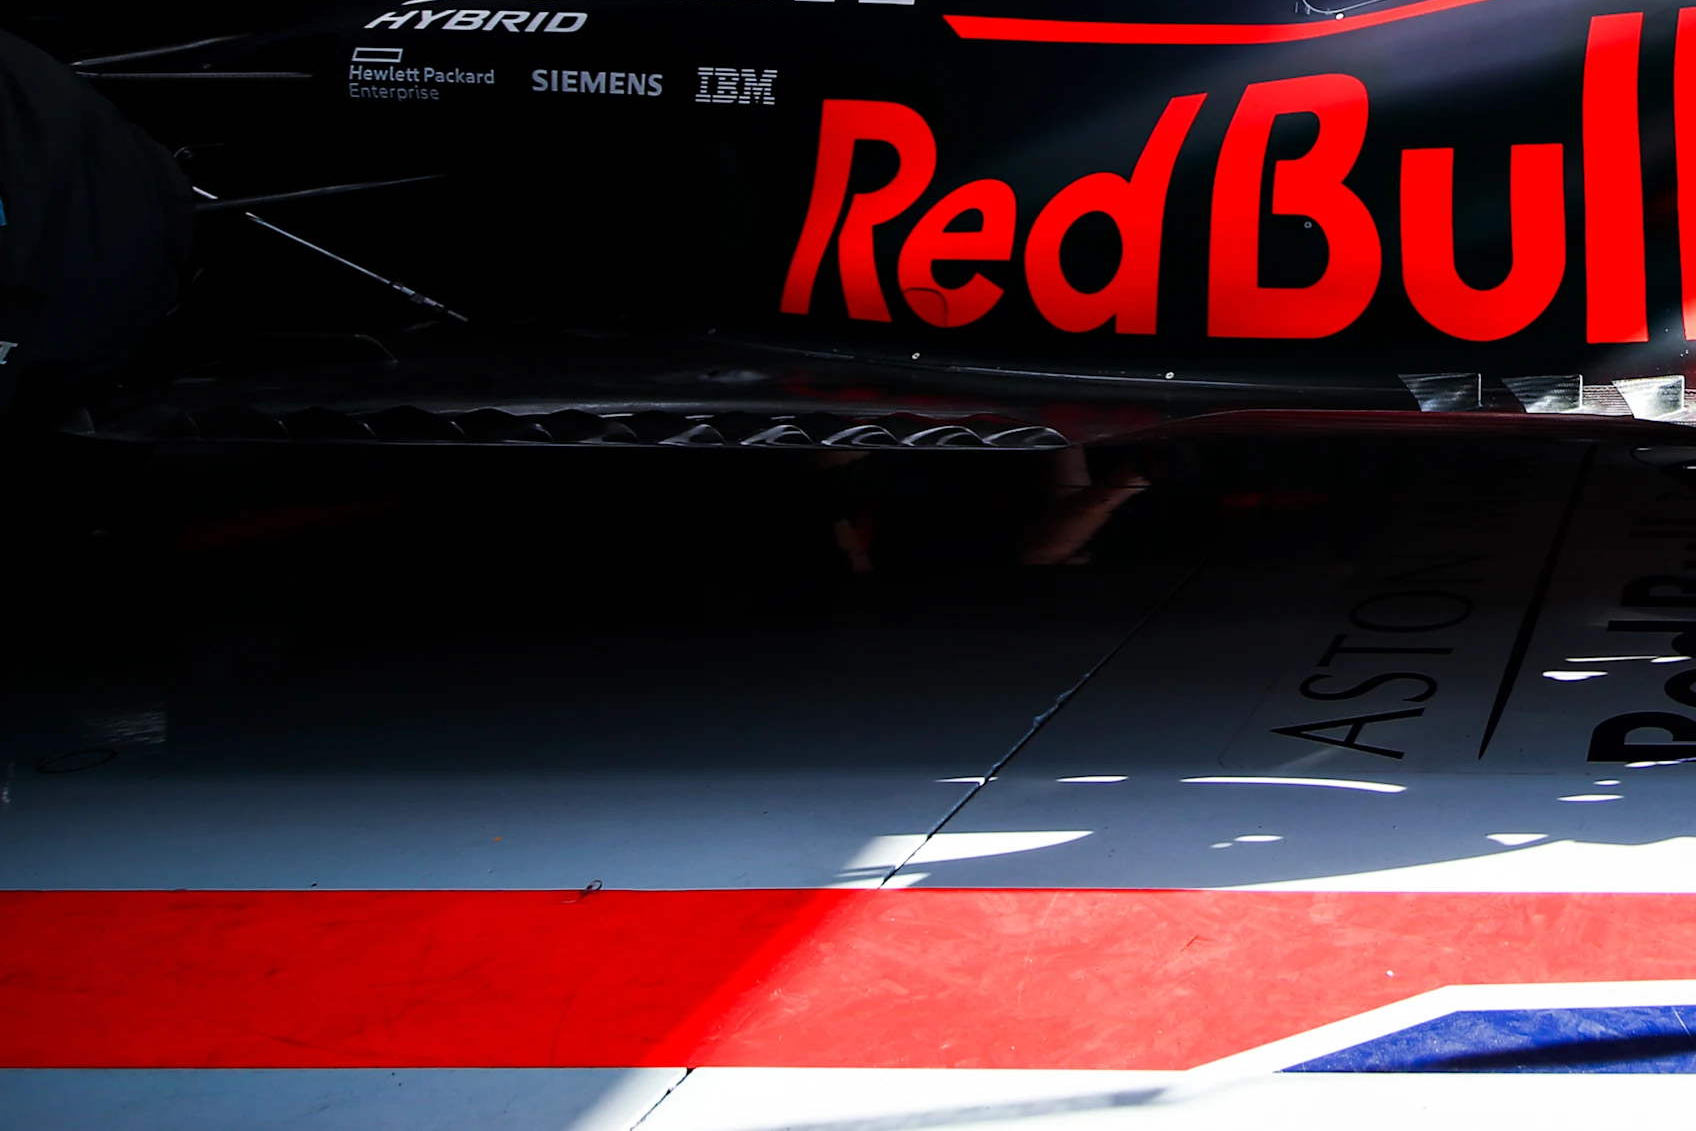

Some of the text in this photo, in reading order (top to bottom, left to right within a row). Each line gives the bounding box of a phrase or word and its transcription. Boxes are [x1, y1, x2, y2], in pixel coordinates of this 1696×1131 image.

[364, 9, 588, 32] HYBRID
[349, 64, 496, 85] Hewlett Packard
[531, 69, 663, 97] SIEMENS
[695, 66, 777, 105] IBM
[348, 83, 440, 101] Enterprise
